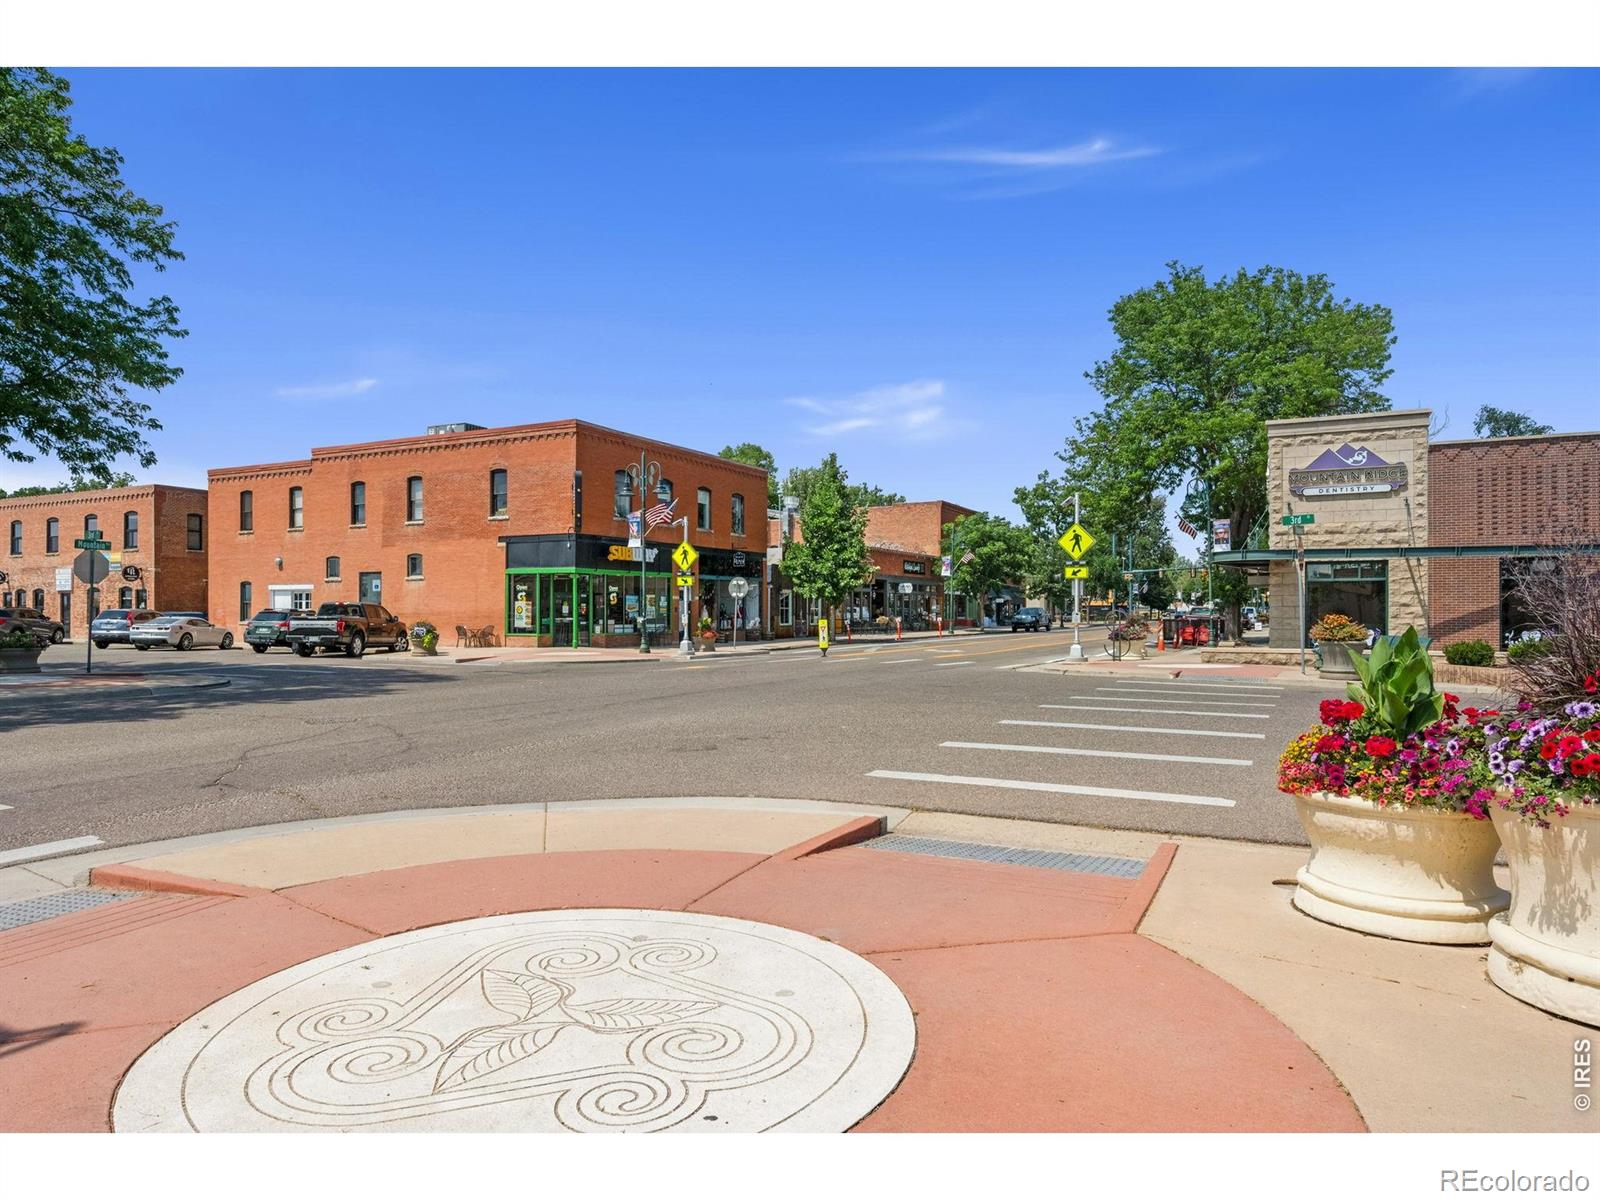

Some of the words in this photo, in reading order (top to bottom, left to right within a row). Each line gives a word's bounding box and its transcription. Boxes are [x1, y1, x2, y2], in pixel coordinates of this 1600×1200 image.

[1289, 471, 1360, 482] MOUNTAIN
[1364, 468, 1408, 480] RIDGE
[1318, 486, 1375, 494] DENTISTRY
[1290, 515, 1302, 525] 3rd
